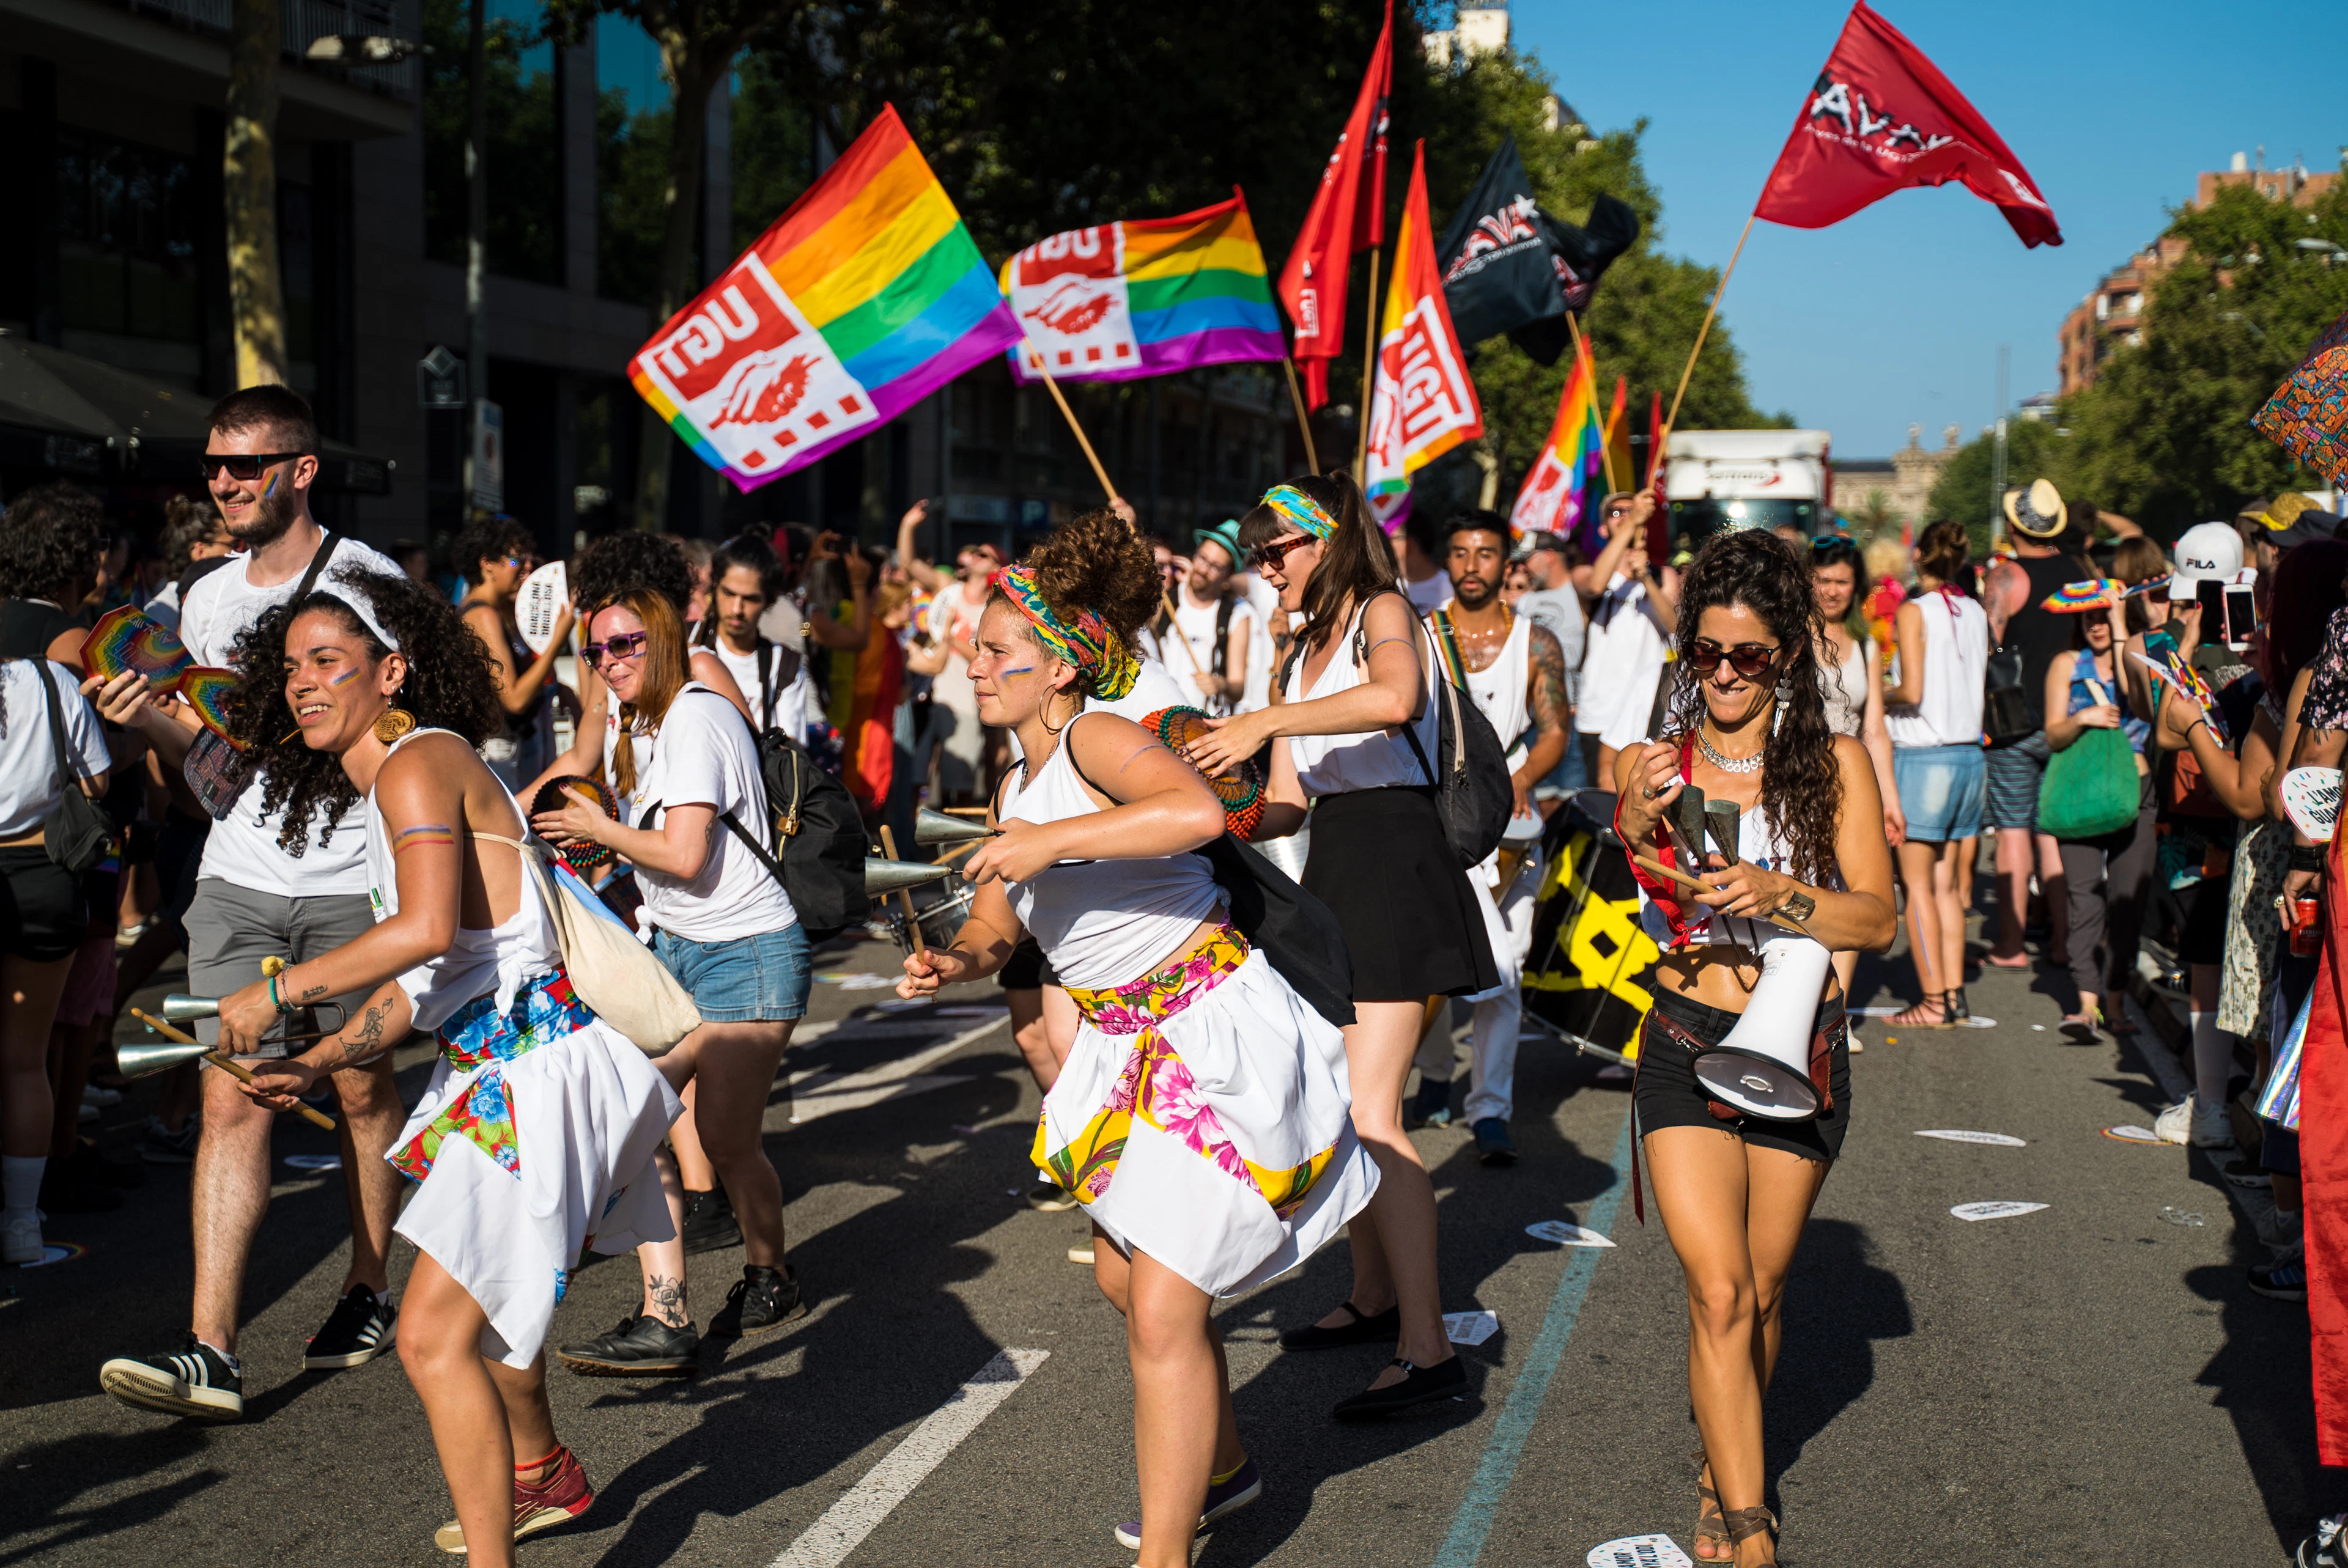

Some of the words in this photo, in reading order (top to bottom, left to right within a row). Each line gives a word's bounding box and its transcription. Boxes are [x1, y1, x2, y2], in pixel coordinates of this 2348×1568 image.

[2186, 558, 2216, 569] FILA
[2306, 786, 2343, 806] L'AMO
[1613, 1552, 1637, 1568] AMOR
